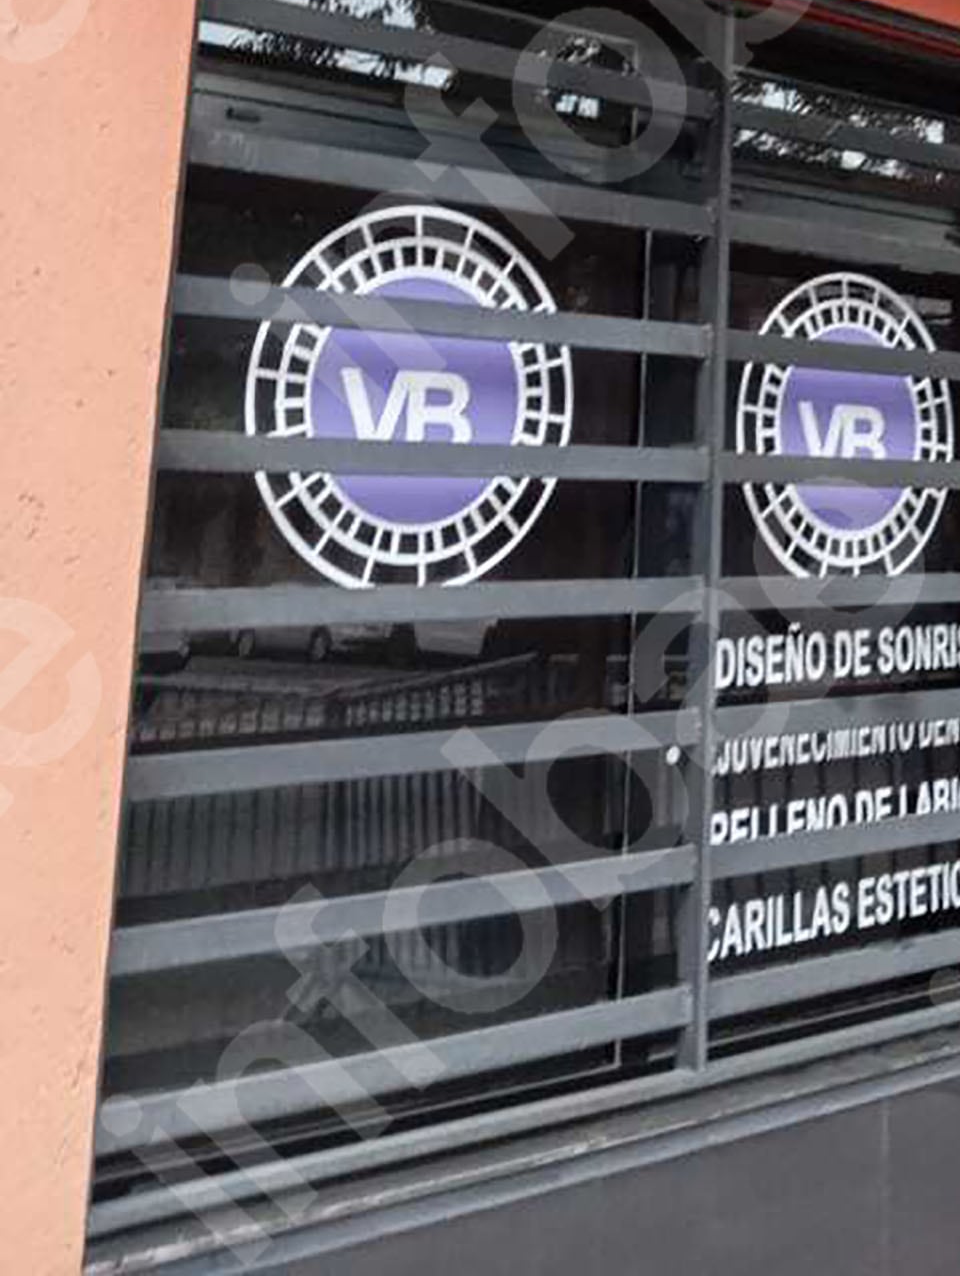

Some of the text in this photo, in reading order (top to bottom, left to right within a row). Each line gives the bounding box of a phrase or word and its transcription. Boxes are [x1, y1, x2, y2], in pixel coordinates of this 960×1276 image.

[715, 622, 826, 689] DISEÑO
[834, 629, 871, 679] DE
[710, 722, 914, 776] JUVENECIMIENTO
[706, 881, 850, 961] CARILLAS
